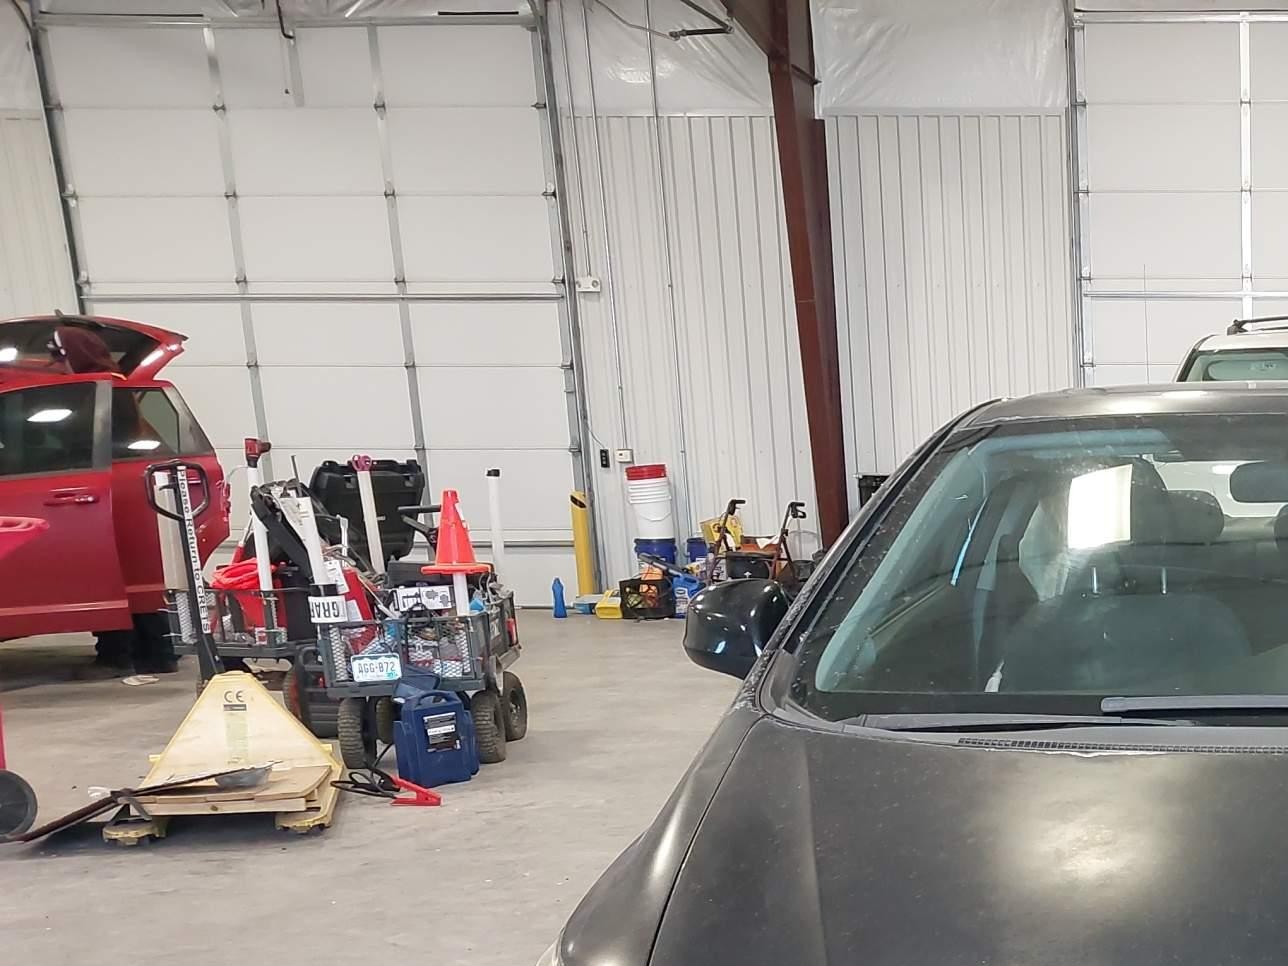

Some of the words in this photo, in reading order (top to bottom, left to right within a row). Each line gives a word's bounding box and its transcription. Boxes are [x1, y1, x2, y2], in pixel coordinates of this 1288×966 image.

[178, 470, 190, 514] Please
[185, 518, 198, 563] Return
[193, 568, 201, 581] to
